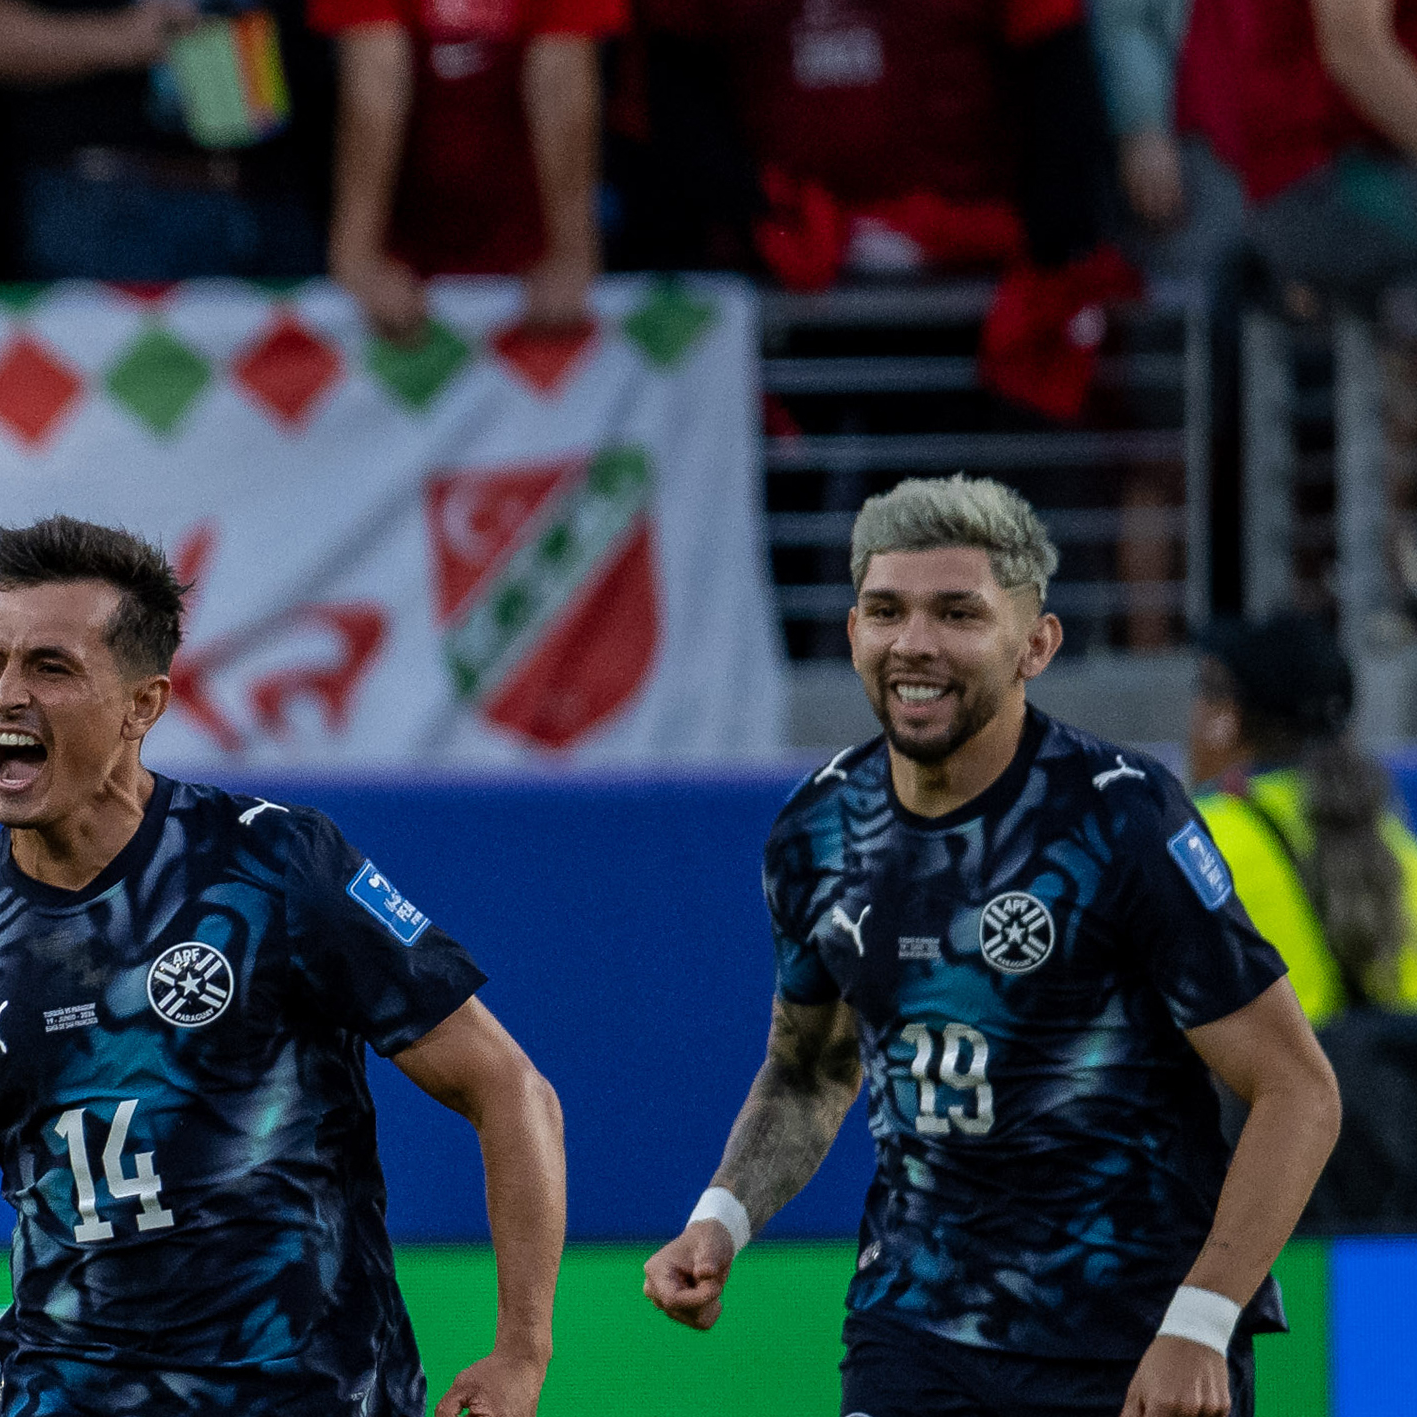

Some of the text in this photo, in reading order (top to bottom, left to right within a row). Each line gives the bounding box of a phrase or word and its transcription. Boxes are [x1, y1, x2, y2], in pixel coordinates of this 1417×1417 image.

[173, 947, 201, 966] APF
[175, 1007, 215, 1022] PARAGUAY
[900, 1022, 995, 1134] 19
[55, 1099, 175, 1244] 14
